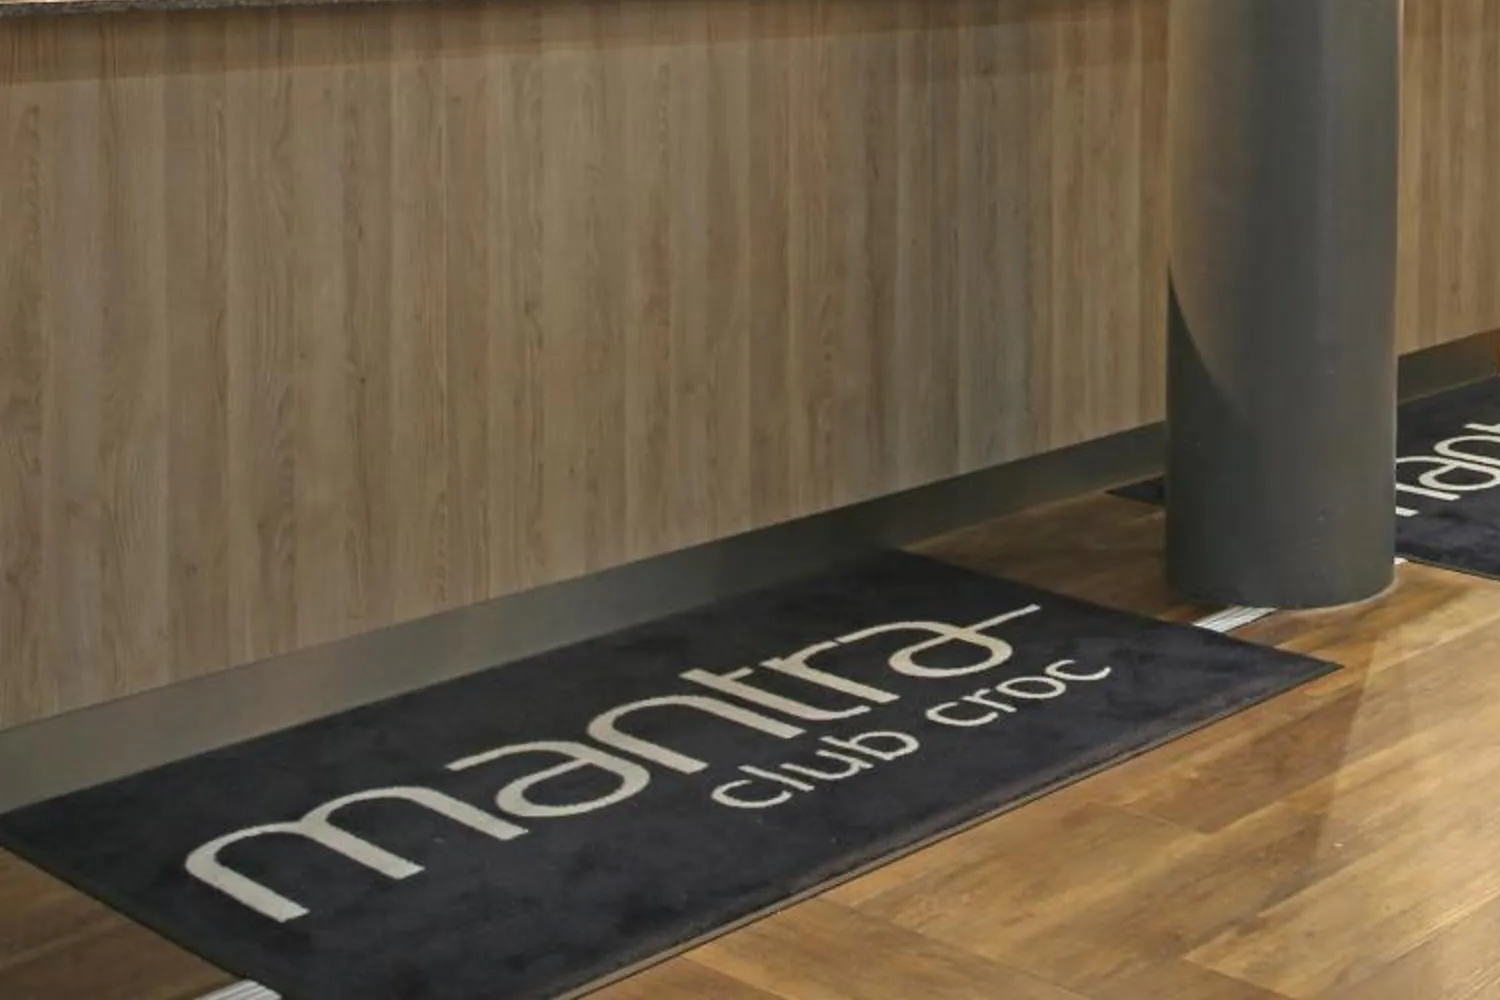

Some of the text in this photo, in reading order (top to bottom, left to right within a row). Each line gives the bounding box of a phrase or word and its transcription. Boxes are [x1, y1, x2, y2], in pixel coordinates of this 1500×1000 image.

[184, 603, 1042, 923] mantra
[710, 656, 1112, 811] club croc
